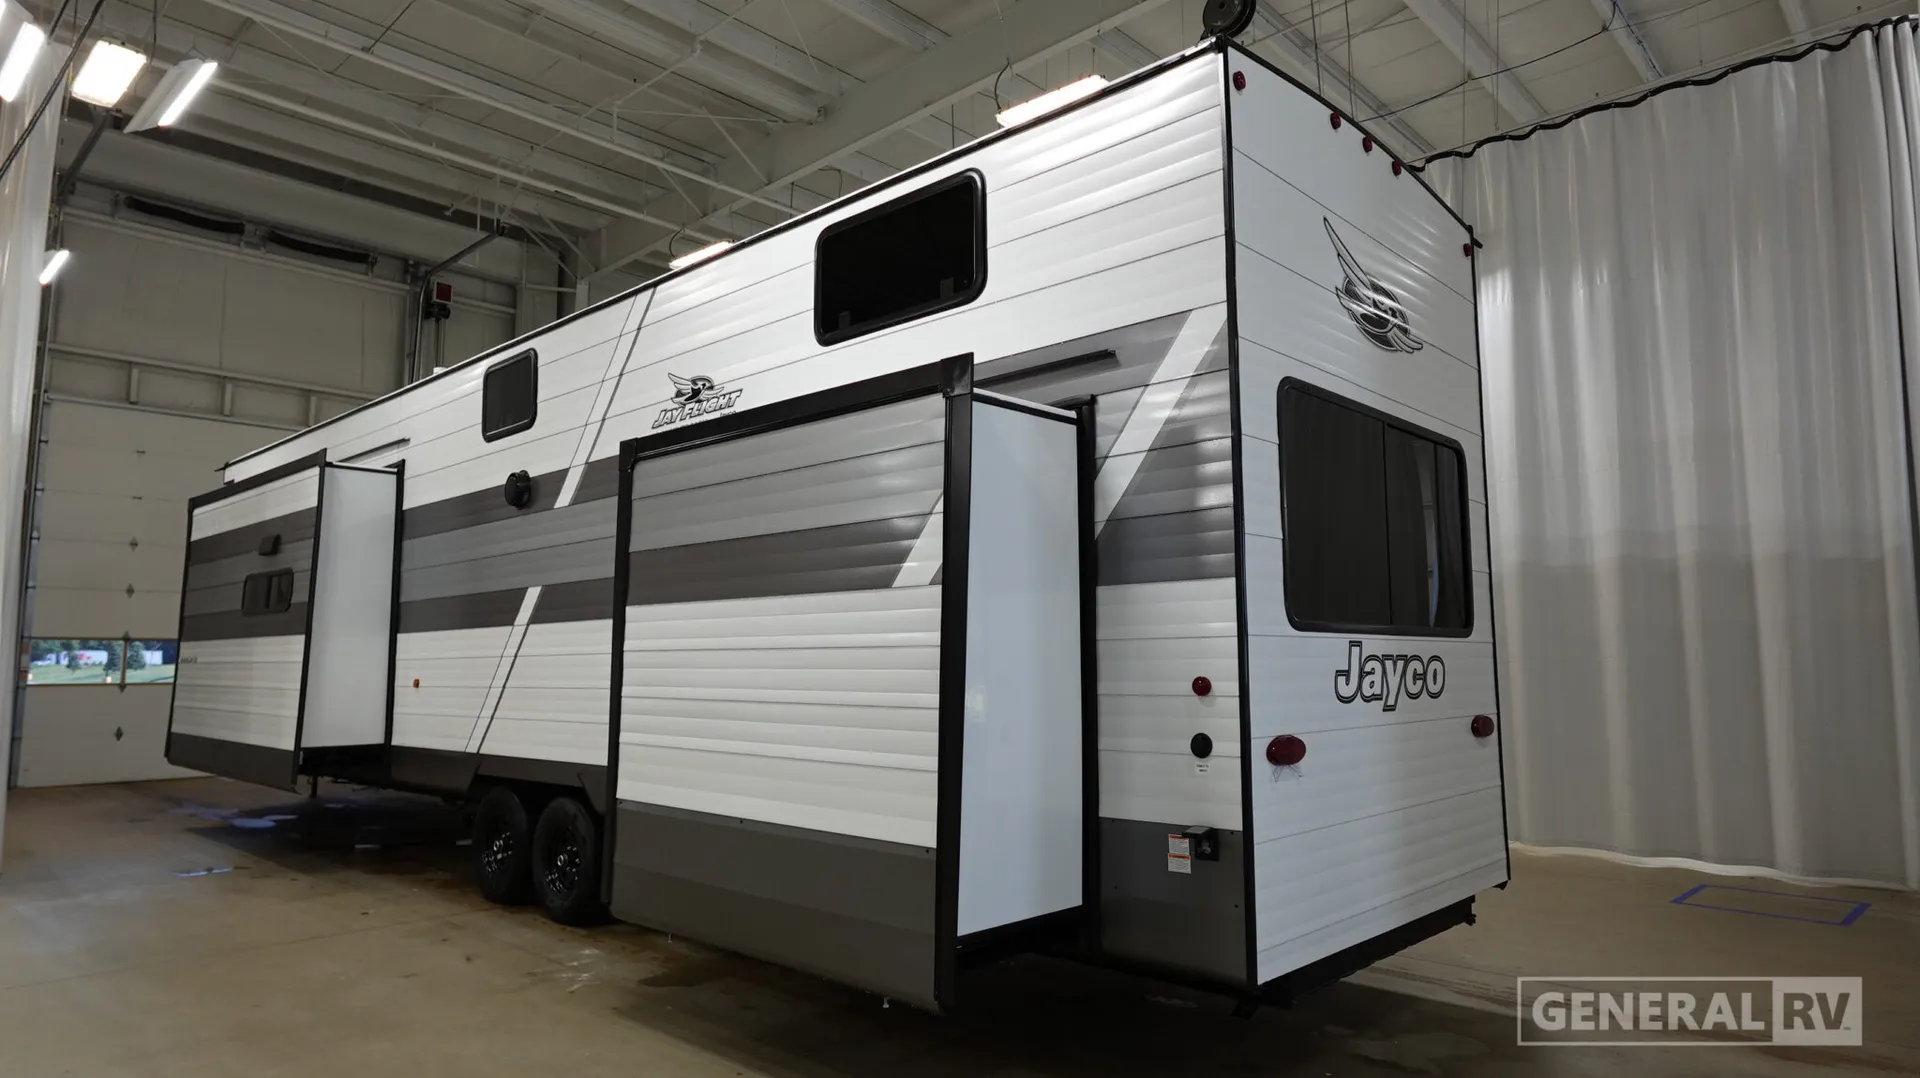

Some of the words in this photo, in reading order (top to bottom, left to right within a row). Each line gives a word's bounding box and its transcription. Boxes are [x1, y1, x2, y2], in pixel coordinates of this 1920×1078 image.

[651, 406, 683, 429] JAY
[680, 388, 743, 420] FLIGHT
[1334, 640, 1445, 712] Jayco
